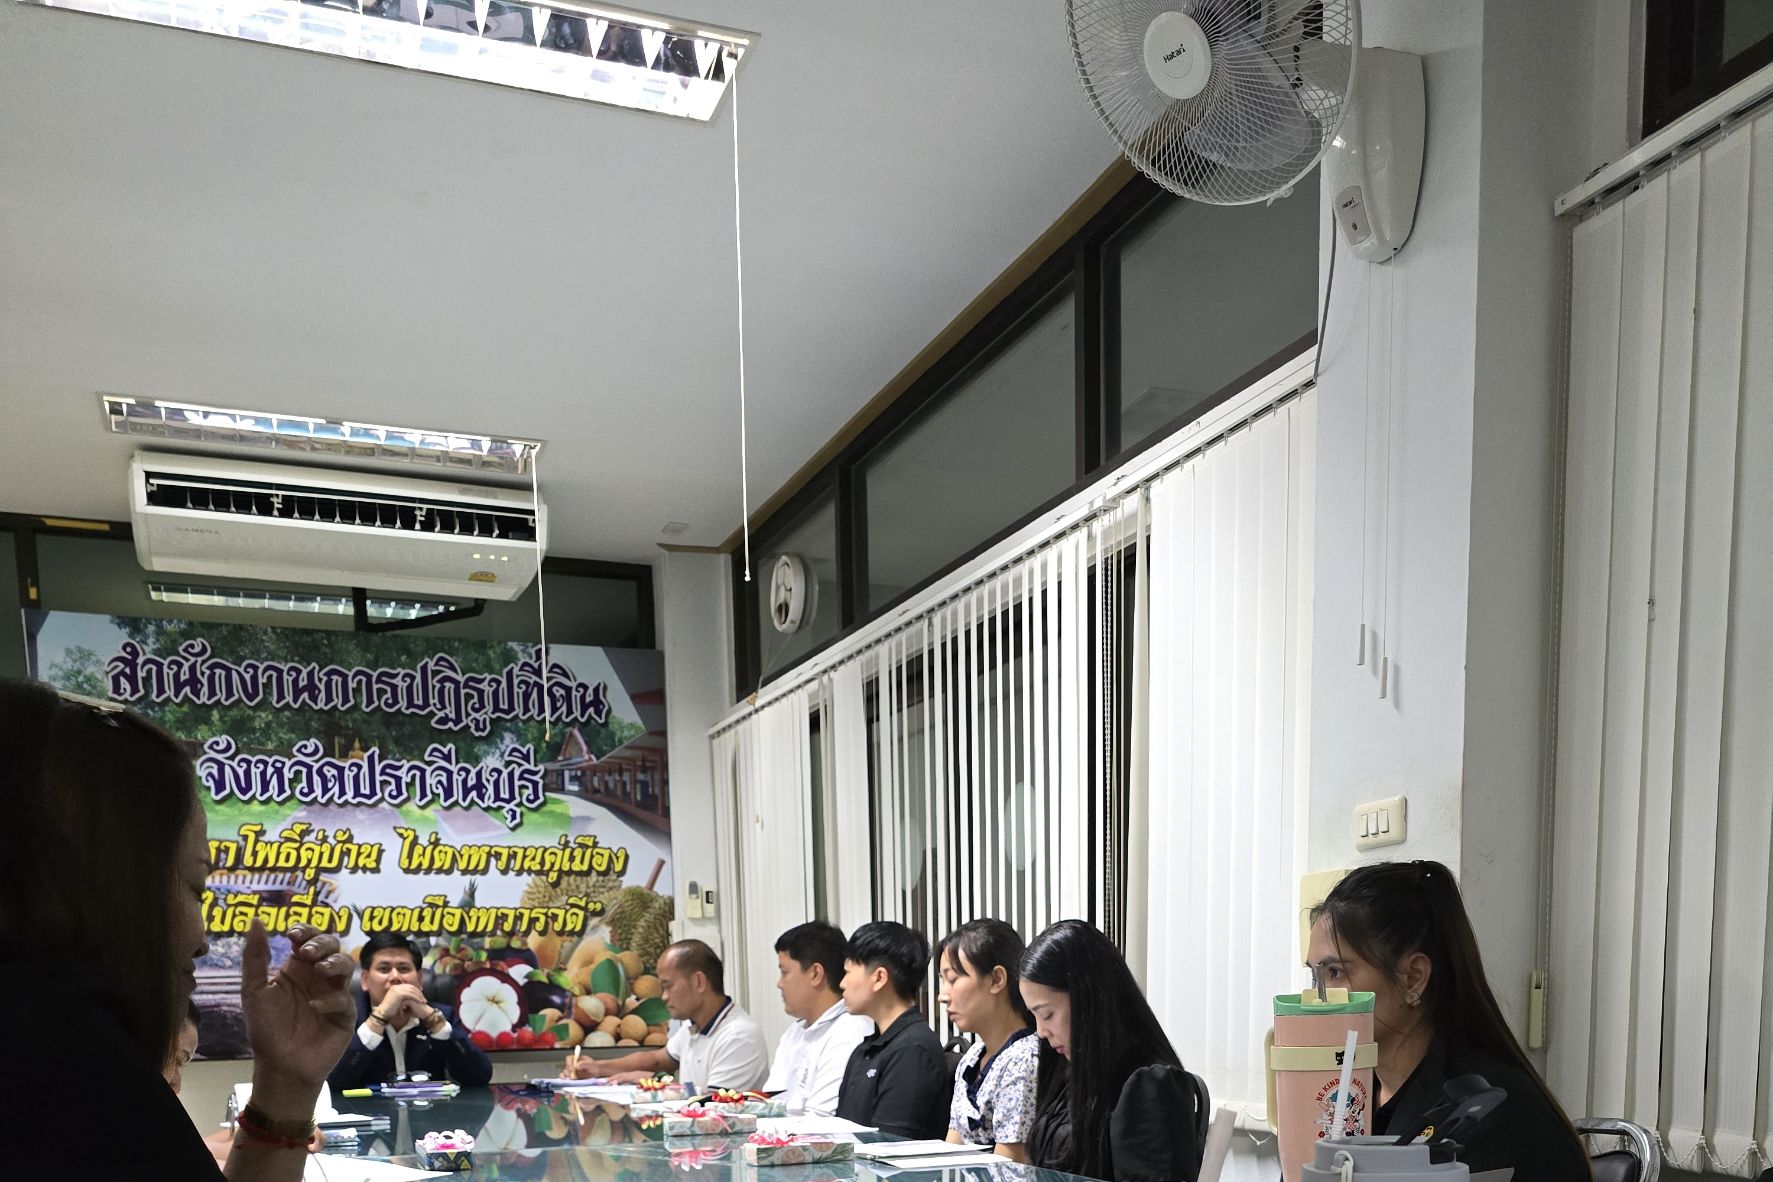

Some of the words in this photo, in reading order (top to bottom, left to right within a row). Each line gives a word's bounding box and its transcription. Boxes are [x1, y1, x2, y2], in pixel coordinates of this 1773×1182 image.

[1162, 43, 1186, 64] Hatari
[105, 639, 607, 737] สำนักงานการปฏิรูปที่ดิน
[199, 735, 547, 830] จังหวัดปราจีนบุรี
[395, 827, 627, 883] ไผ่ตงหวานคู่เมือง
[1316, 1091, 1325, 1102] BE
[1322, 1078, 1340, 1093] KIND
